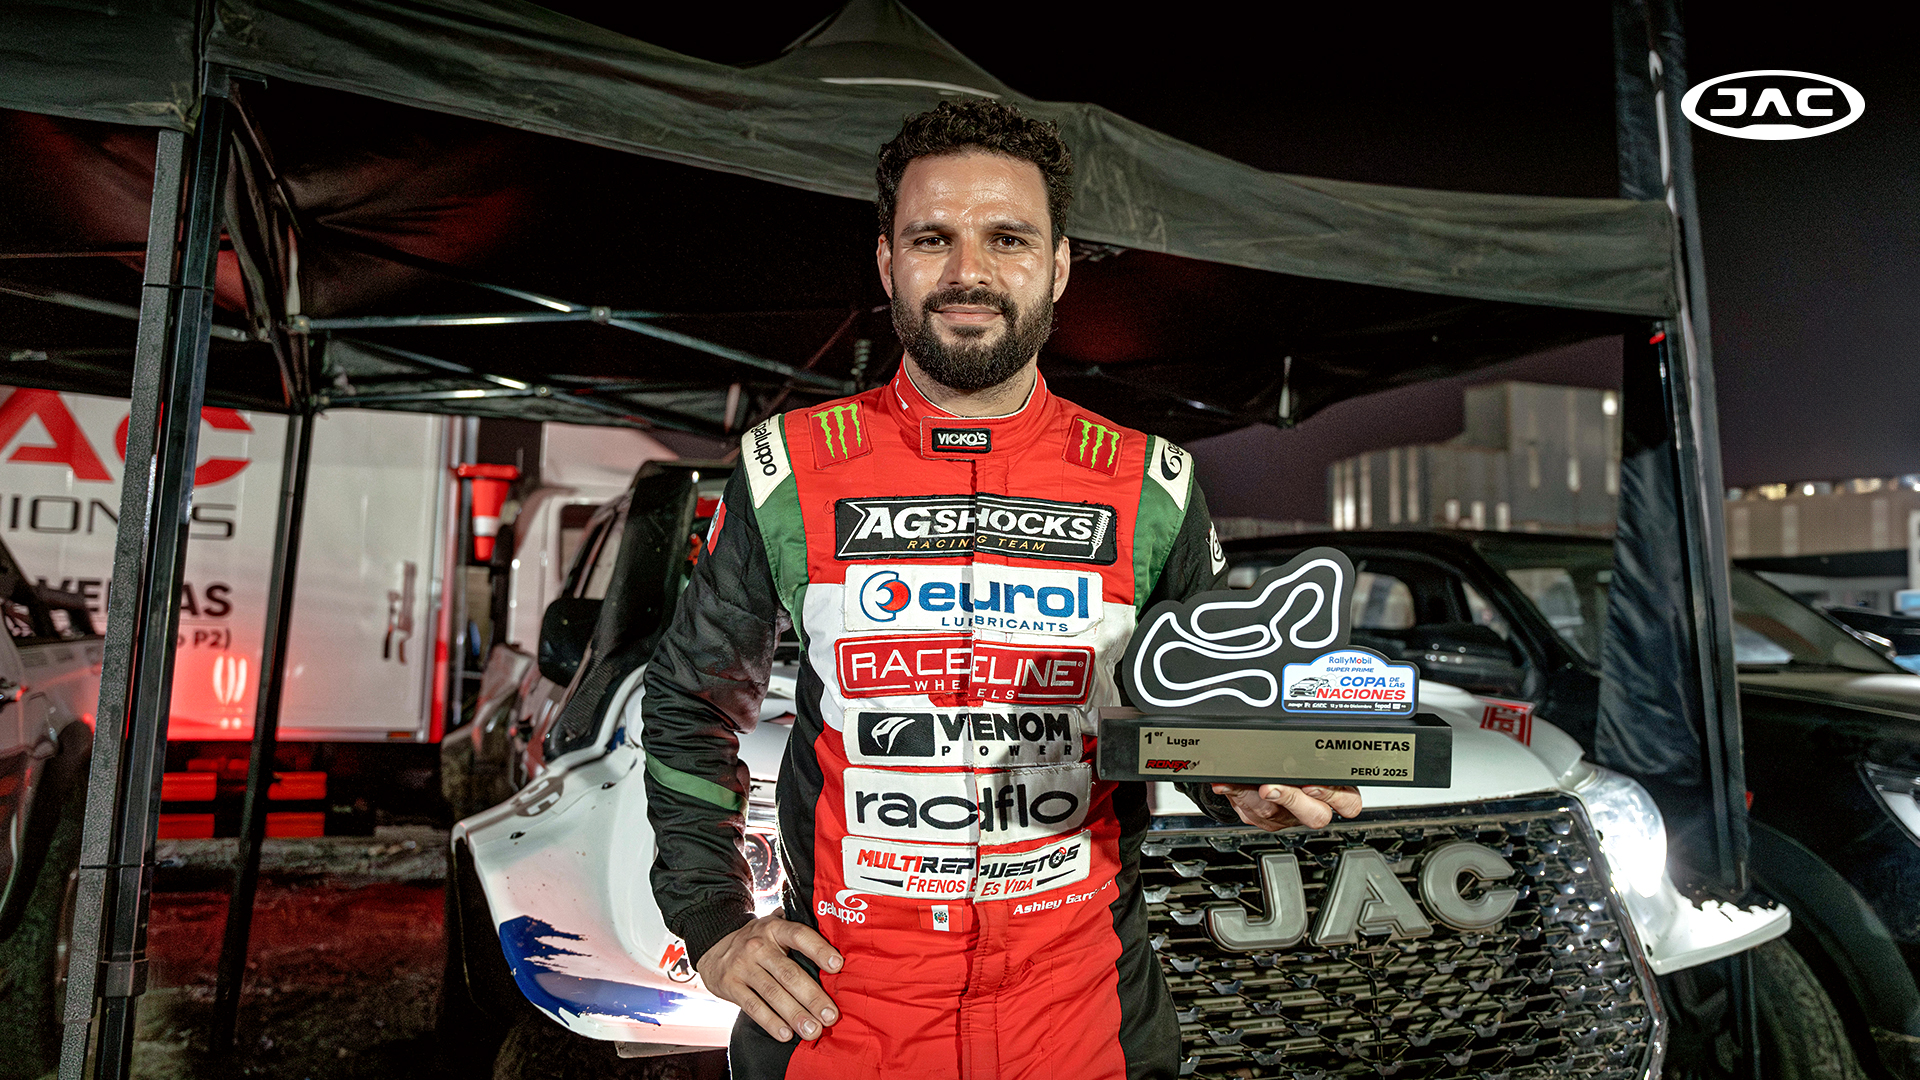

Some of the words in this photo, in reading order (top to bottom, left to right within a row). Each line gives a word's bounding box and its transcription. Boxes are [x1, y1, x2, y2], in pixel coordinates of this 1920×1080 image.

[937, 432, 988, 446] VICKO'S
[906, 534, 988, 549] RACING
[998, 537, 1046, 551] TEAM
[918, 576, 1089, 619] eurol
[941, 614, 1069, 632] LUBRICANTS
[1329, 656, 1372, 666] RallyMobil
[1340, 676, 1386, 688] COPA
[914, 679, 1015, 700] WHEELS
[1315, 688, 1406, 700] NACIONES
[936, 712, 1072, 741] VENOM
[1167, 736, 1200, 747] Lugar
[1314, 739, 1410, 751] CAMIONETAS
[941, 745, 1072, 756] POWER
[1350, 766, 1380, 777] PERÚ
[1383, 768, 1408, 777] 2025
[1204, 841, 1518, 953] JAC
[1013, 899, 1062, 916] Ashley
